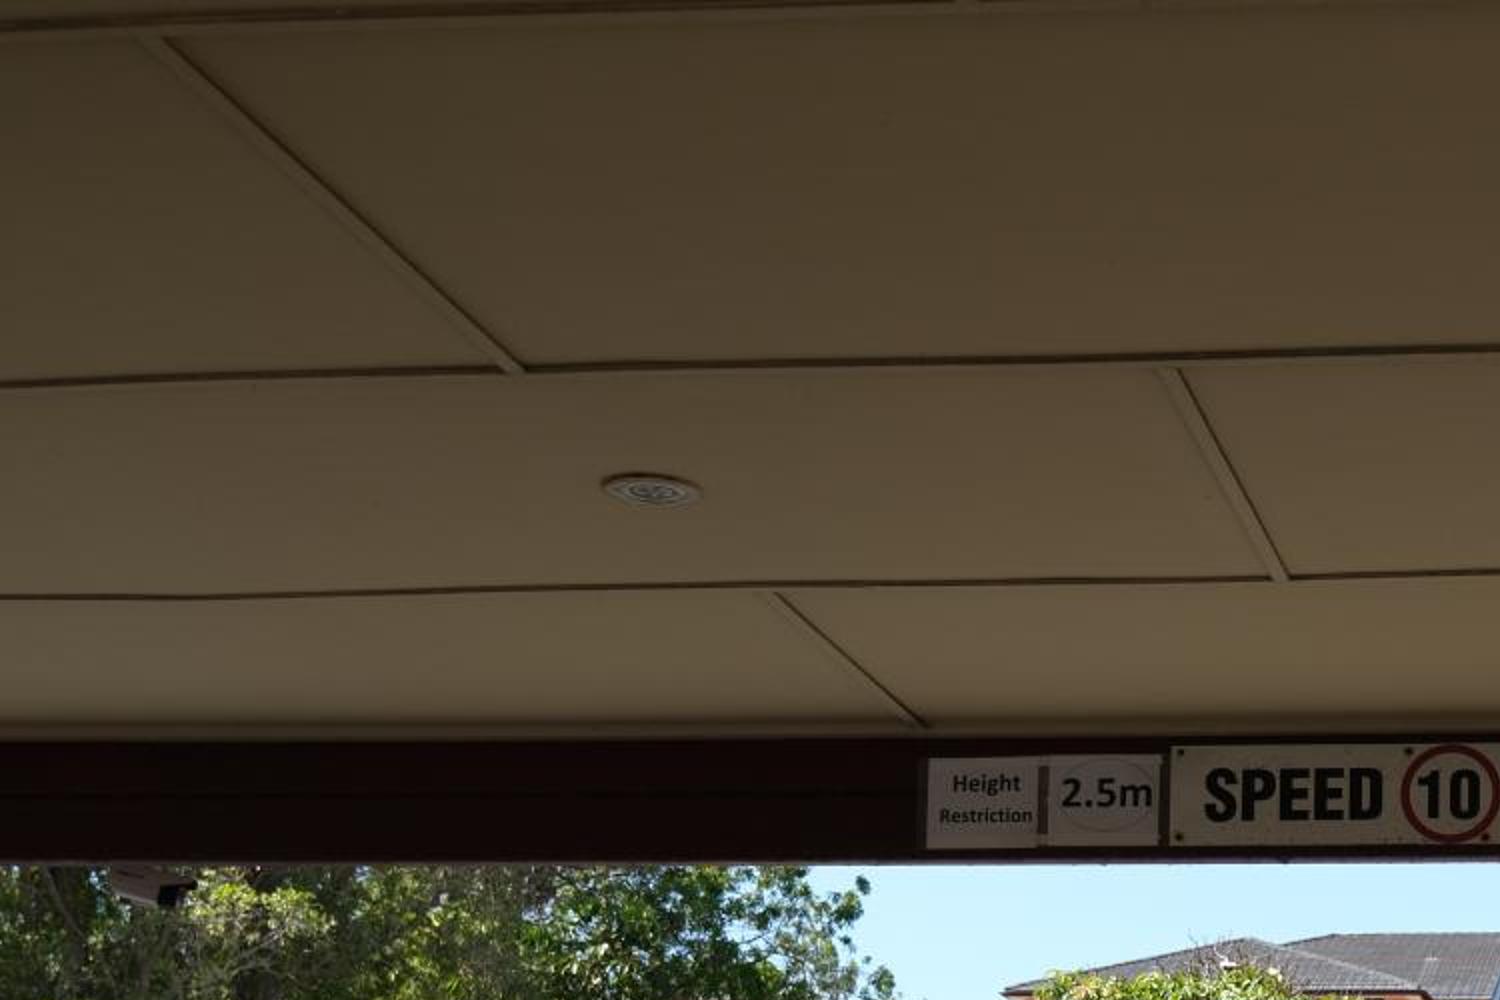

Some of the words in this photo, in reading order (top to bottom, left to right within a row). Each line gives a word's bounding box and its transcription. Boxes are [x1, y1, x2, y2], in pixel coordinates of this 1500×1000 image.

[952, 773, 1021, 796] Height
[1061, 777, 1153, 807] 2.5m
[1204, 767, 1383, 822] SPEED
[1417, 768, 1480, 820] 10
[939, 807, 1033, 824] Restriction
